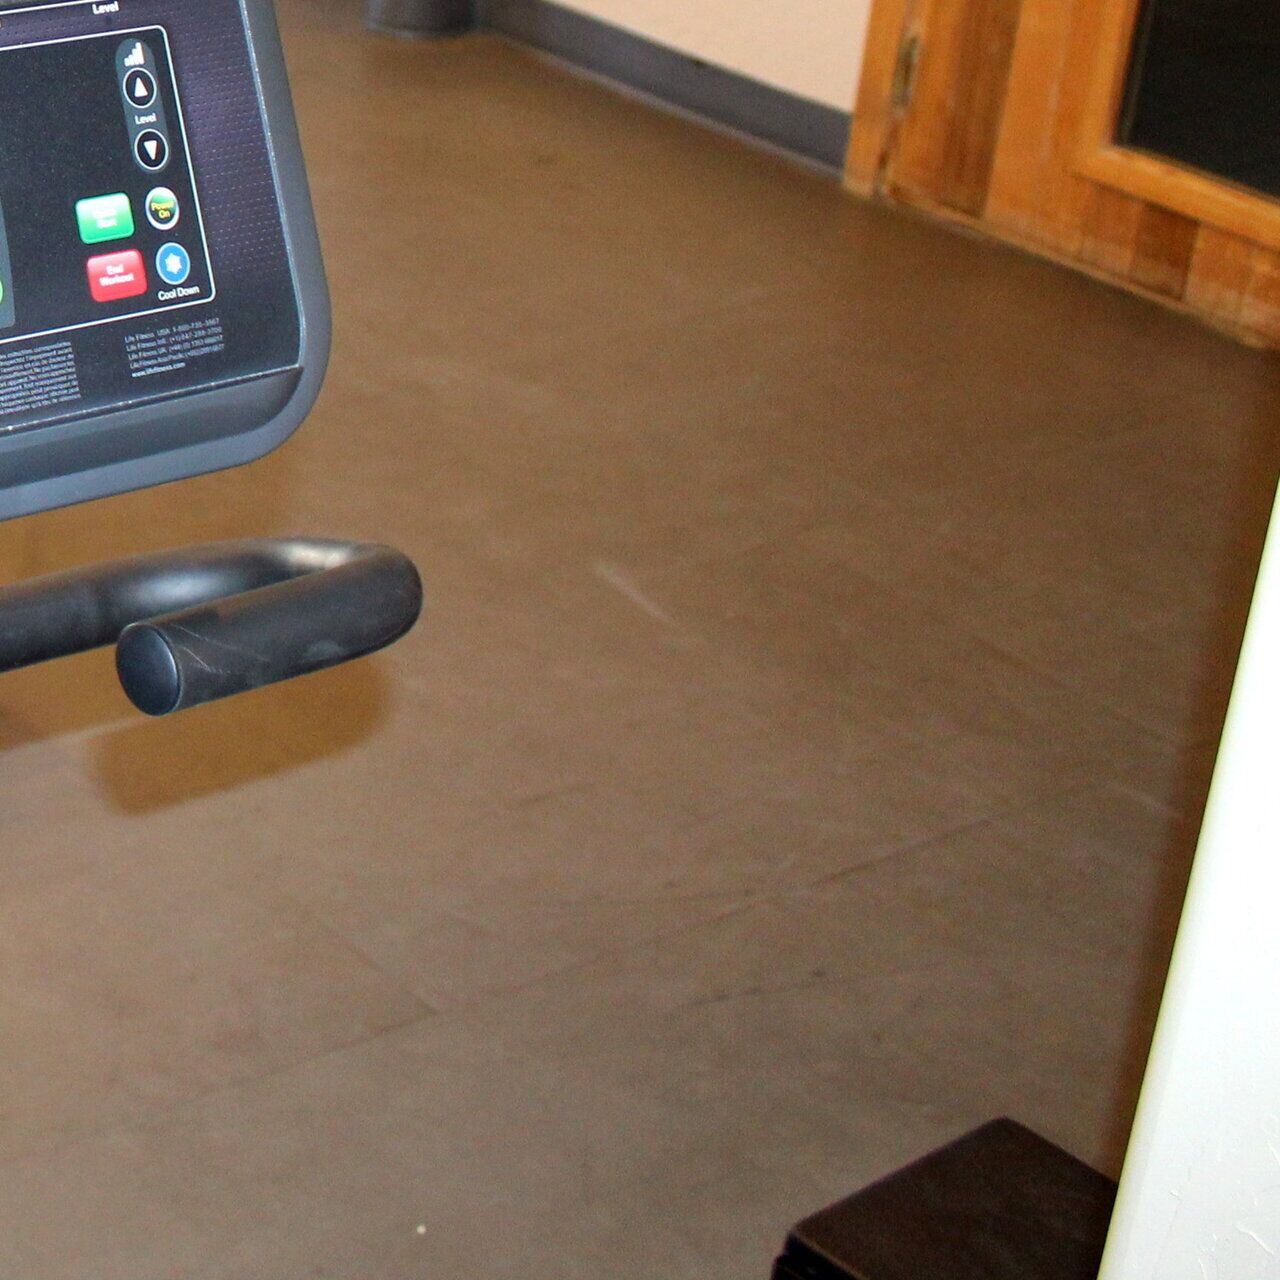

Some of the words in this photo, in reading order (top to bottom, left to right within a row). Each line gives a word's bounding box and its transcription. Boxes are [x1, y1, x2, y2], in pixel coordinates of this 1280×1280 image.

[92, 1, 119, 15] Level
[135, 113, 157, 125] Level
[158, 209, 171, 219] On
[158, 289, 177, 301] Cool
[177, 285, 200, 298] Down
